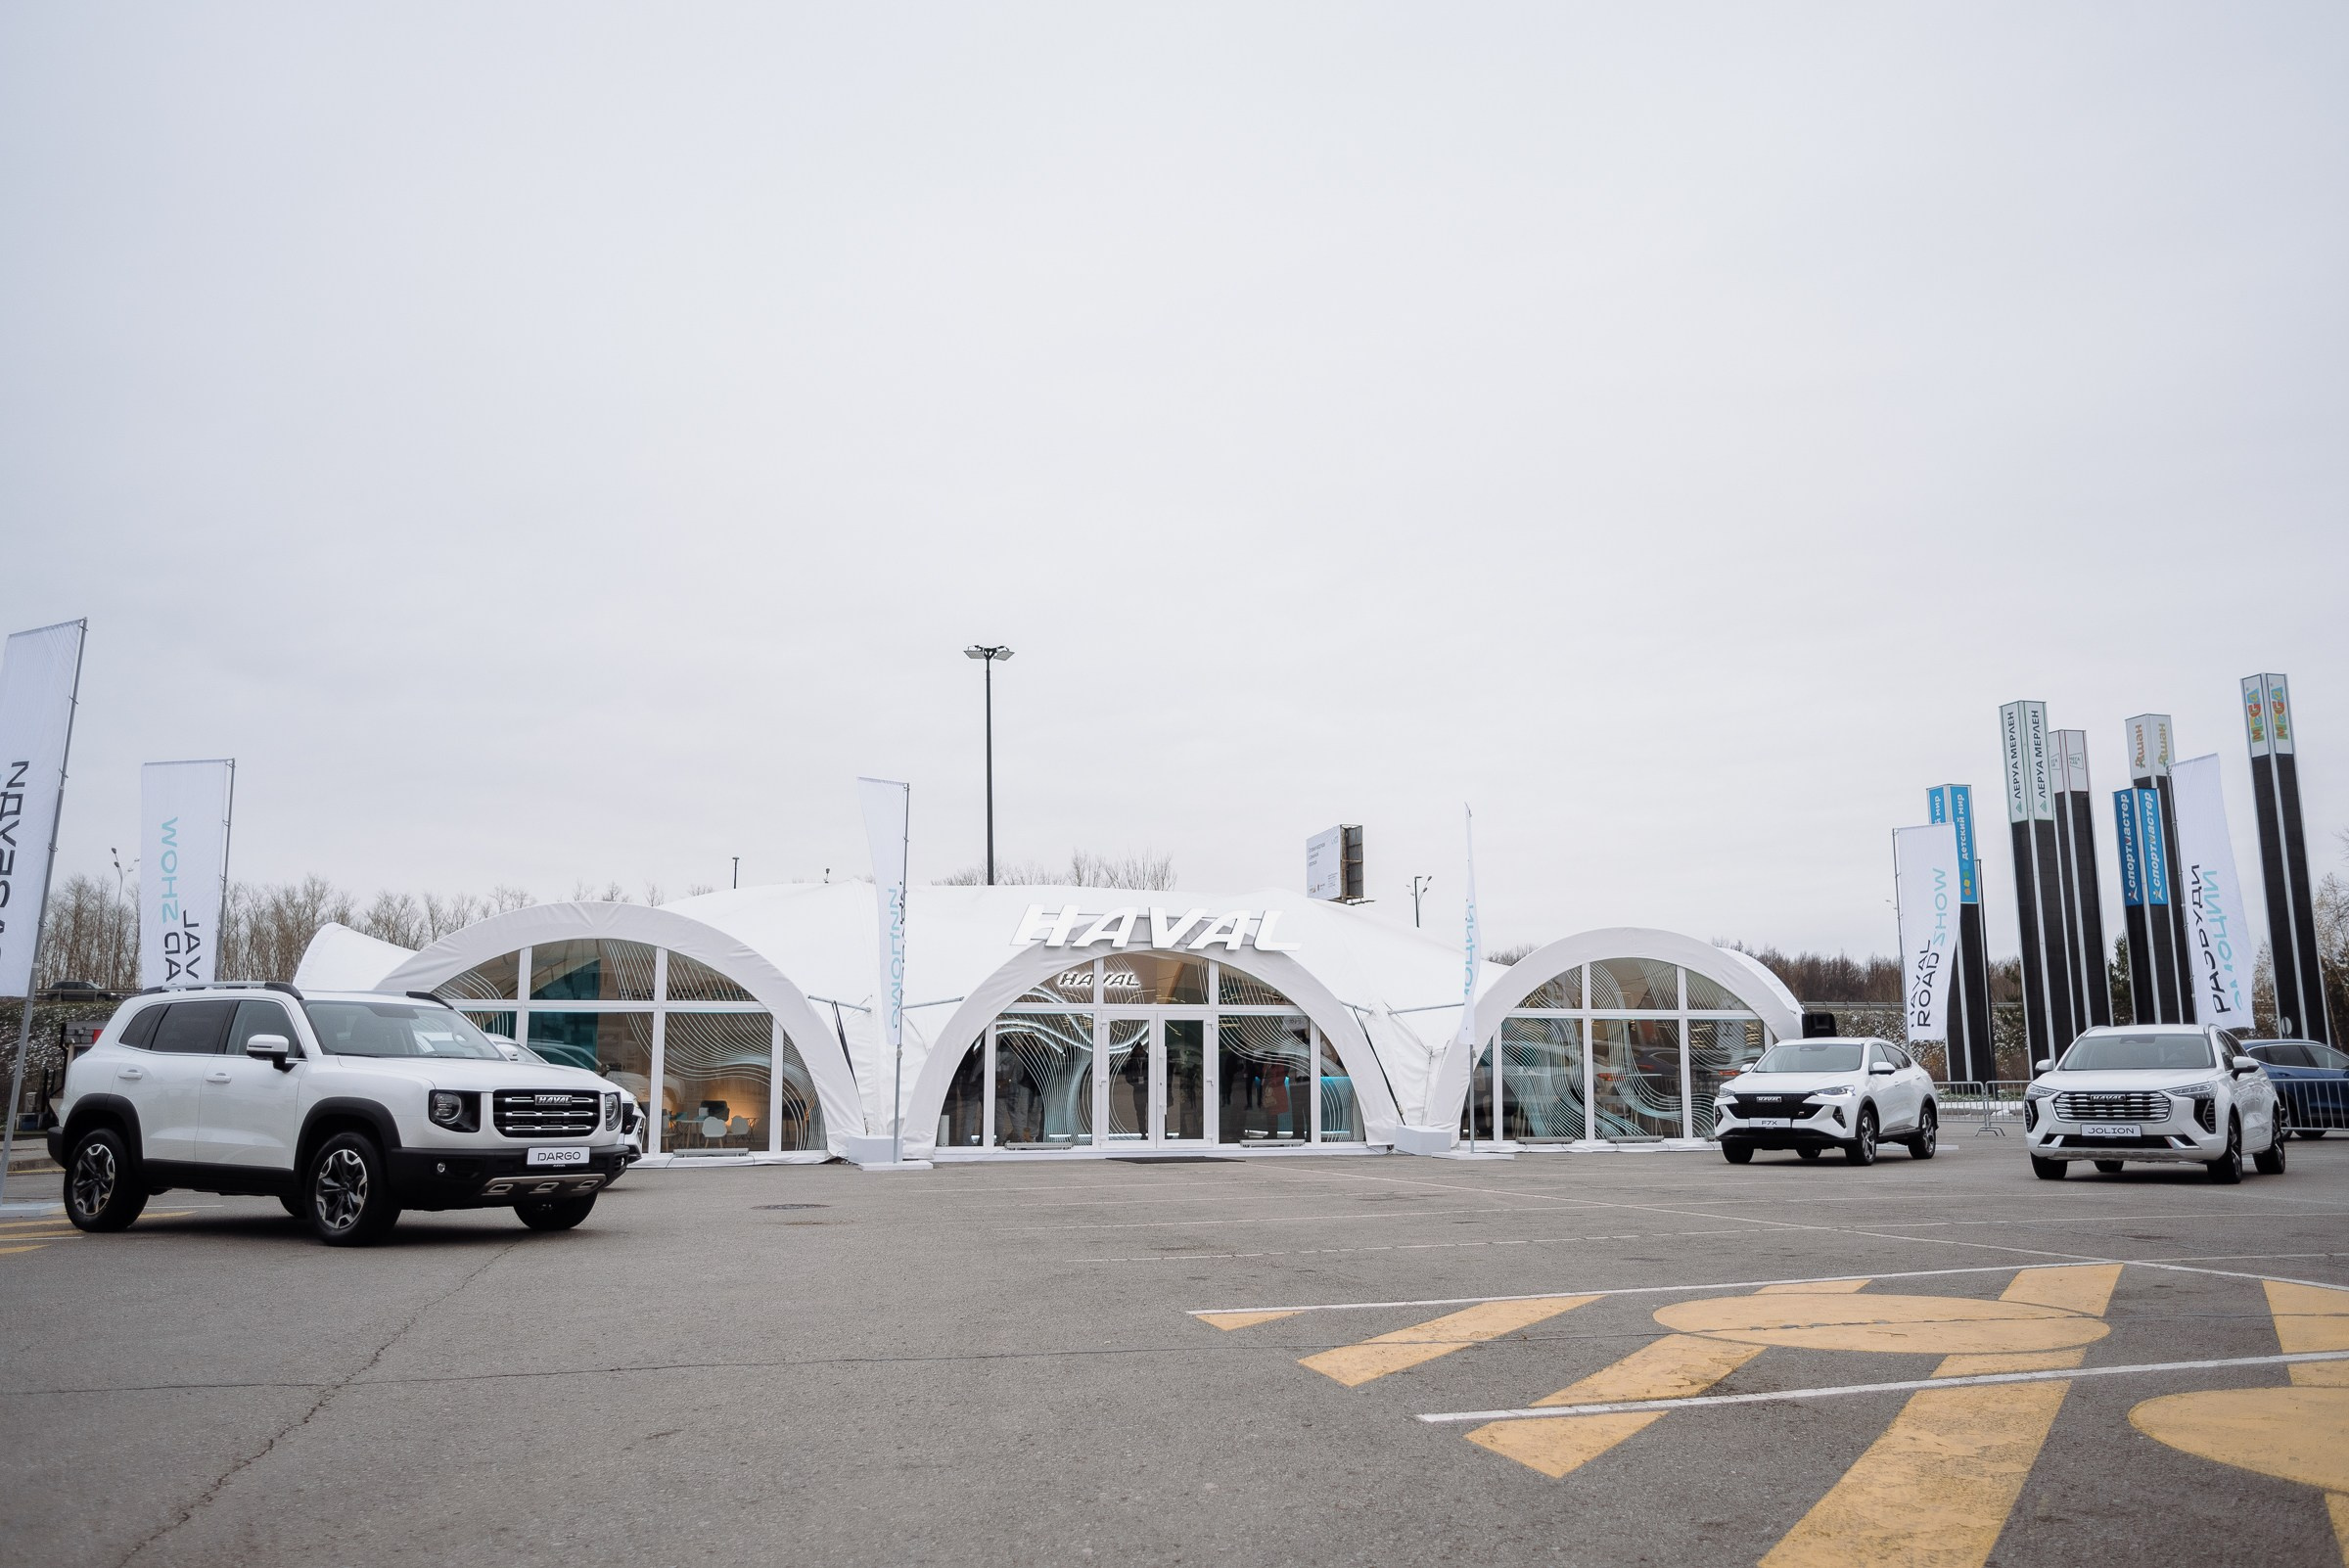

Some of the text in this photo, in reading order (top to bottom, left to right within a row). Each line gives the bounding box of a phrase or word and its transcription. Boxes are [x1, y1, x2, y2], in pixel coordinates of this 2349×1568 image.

[2007, 712, 2021, 799] ЛЕРУА МЕРЛЕН
[2031, 710, 2046, 799] ЛЕРУА МЕРЛЕН
[1957, 794, 1969, 860] детский мир
[2120, 793, 2136, 889] спортмастер
[2143, 791, 2161, 887] спортмастер
[1009, 902, 1303, 951] HAVAL
[1917, 867, 1948, 1027] ROAD SHOW
[1911, 940, 1931, 1028] AVAL
[537, 1151, 581, 1162] DARGO
